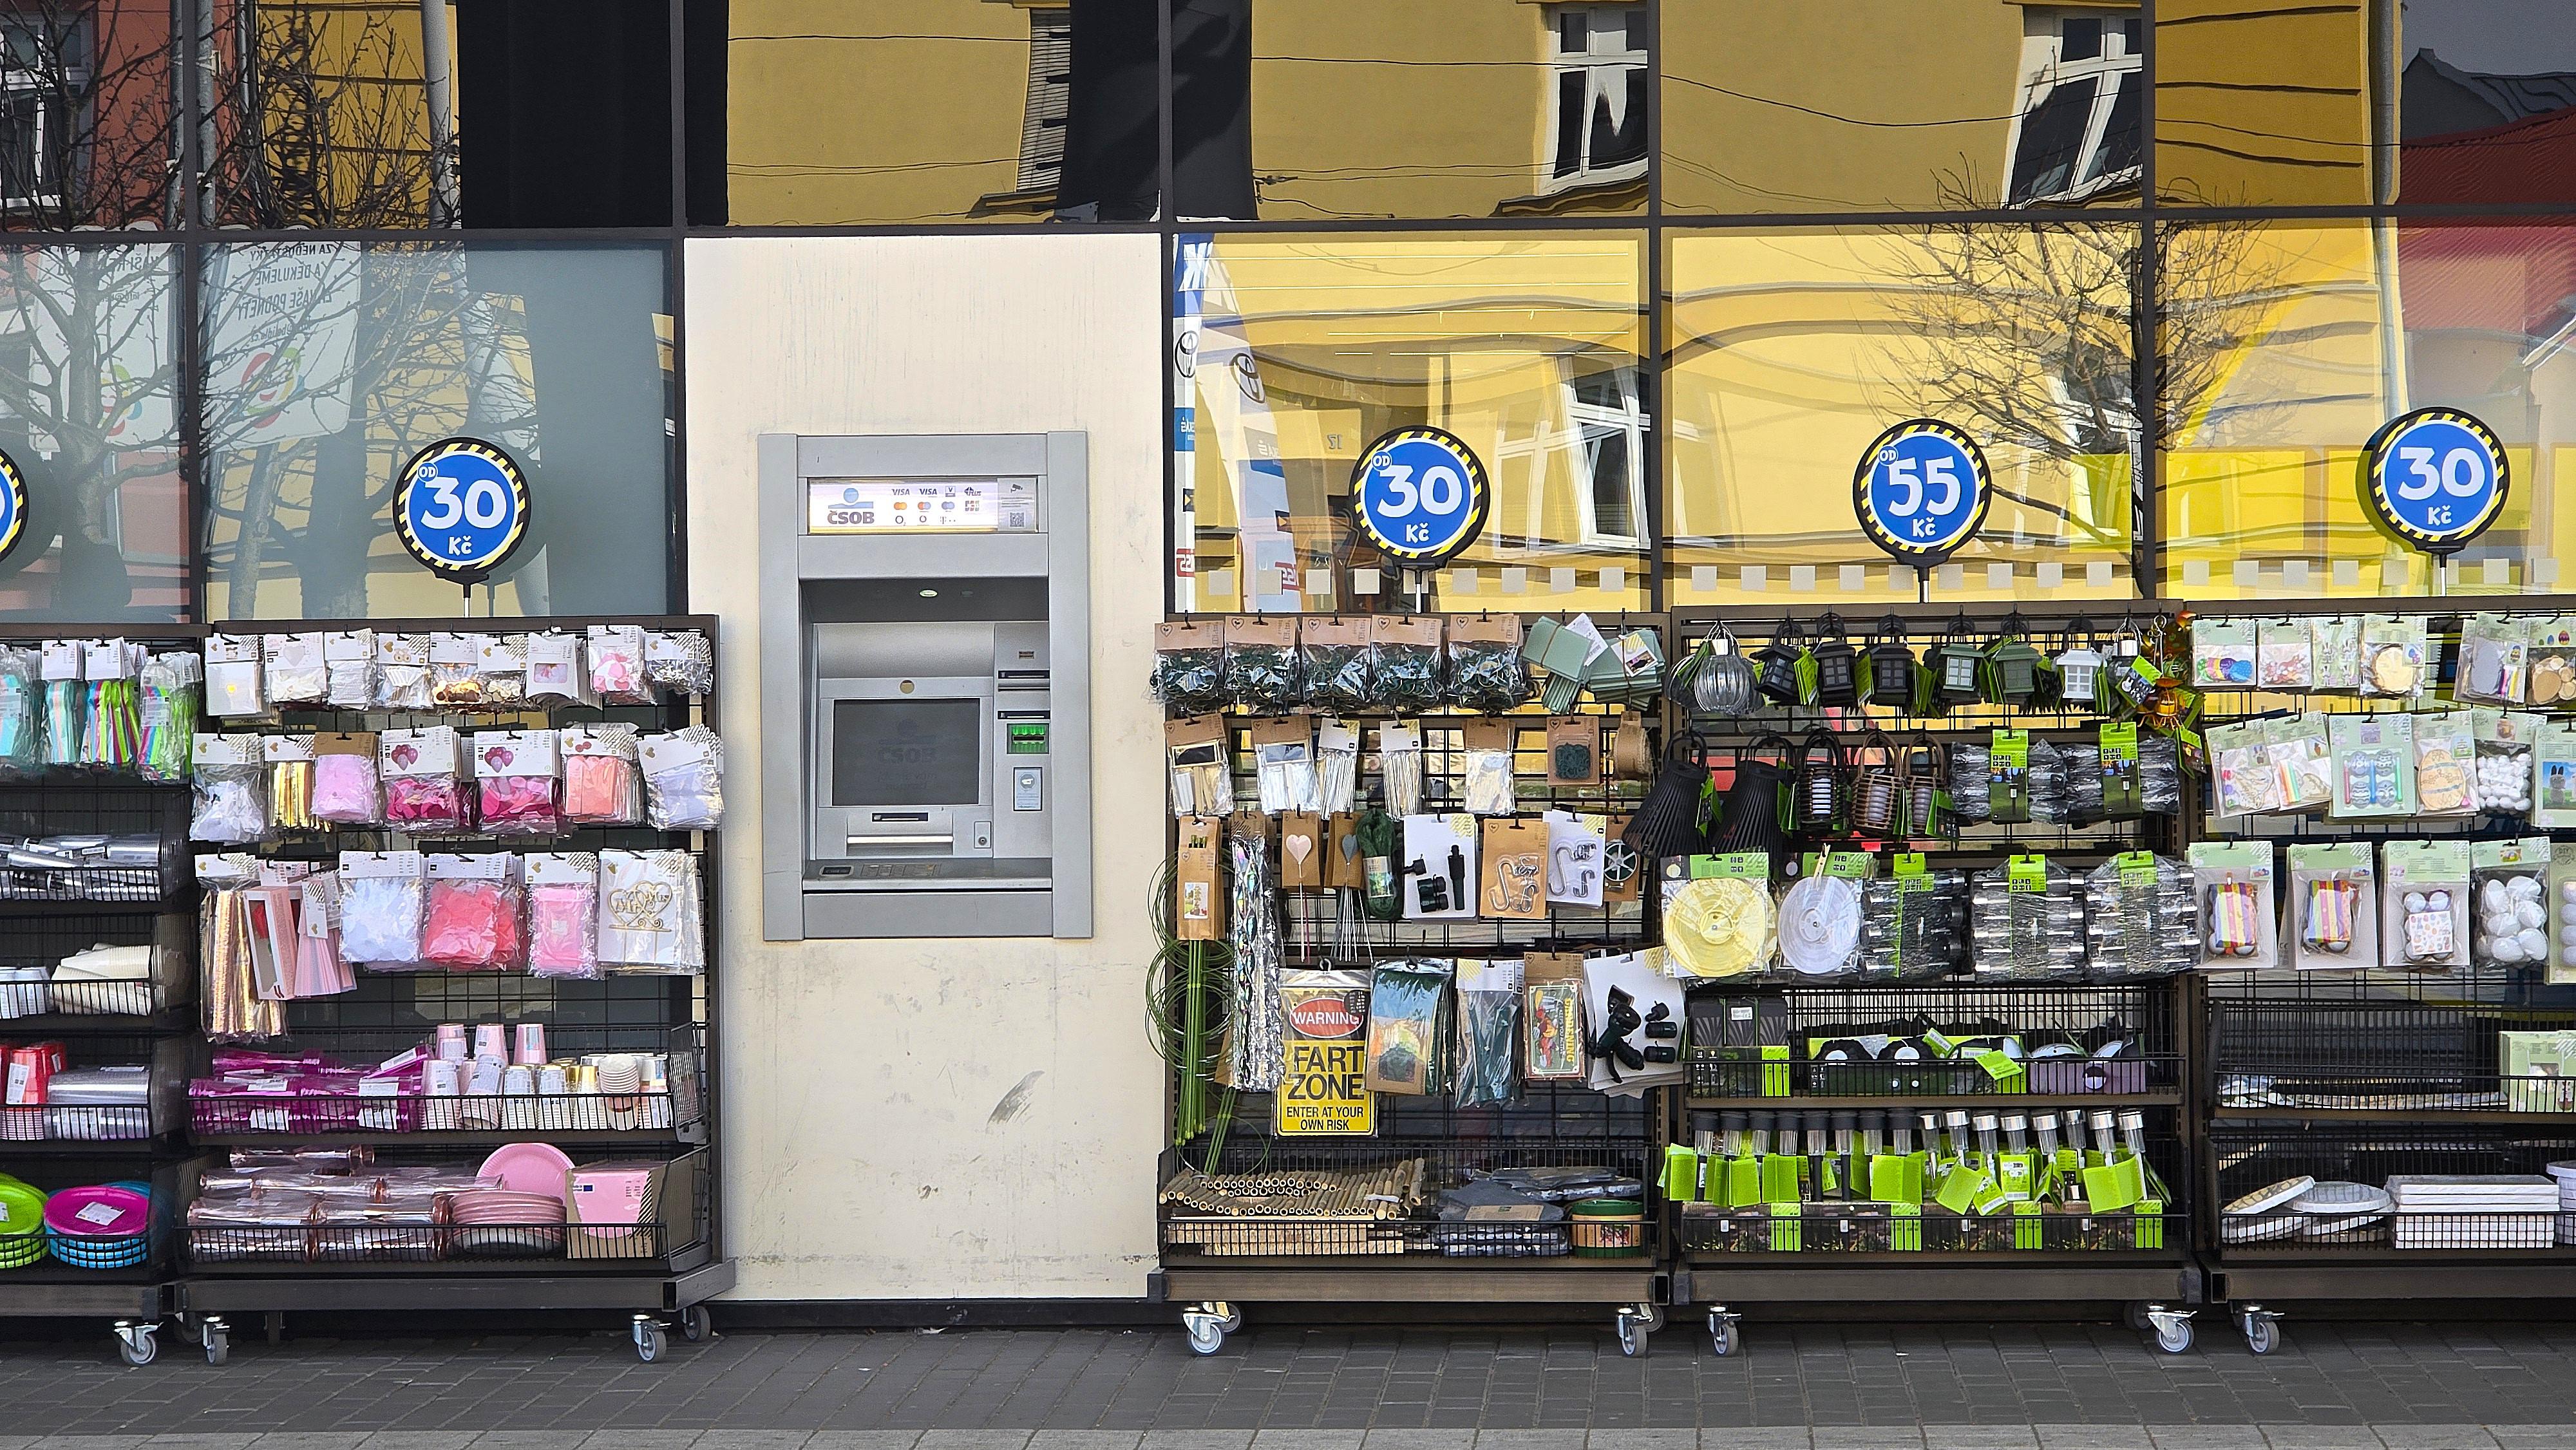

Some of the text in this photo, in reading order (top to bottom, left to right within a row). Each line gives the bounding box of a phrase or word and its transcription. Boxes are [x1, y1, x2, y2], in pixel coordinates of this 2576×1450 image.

[1372, 455, 1390, 467] OD
[1879, 449, 1897, 462] OD
[419, 466, 436, 478] OD
[2398, 447, 2485, 500] 30
[1377, 465, 1463, 518] 30
[1888, 456, 1961, 516] 55
[421, 476, 507, 529] 30
[827, 510, 875, 525] ČSOB
[2428, 505, 2452, 526] Kč
[1406, 522, 1430, 543] Kč
[1912, 516, 1936, 538] Kč
[448, 535, 472, 556] Kč
[1293, 1012, 1359, 1025] WARNING
[1564, 998, 1575, 1062] GARDENING
[1293, 1046, 1365, 1072] FART
[1287, 1073, 1365, 1100] ZONE
[1287, 1106, 1363, 1118] ENTER AT YOUR
[1300, 1119, 1350, 1131] OWN RISK
